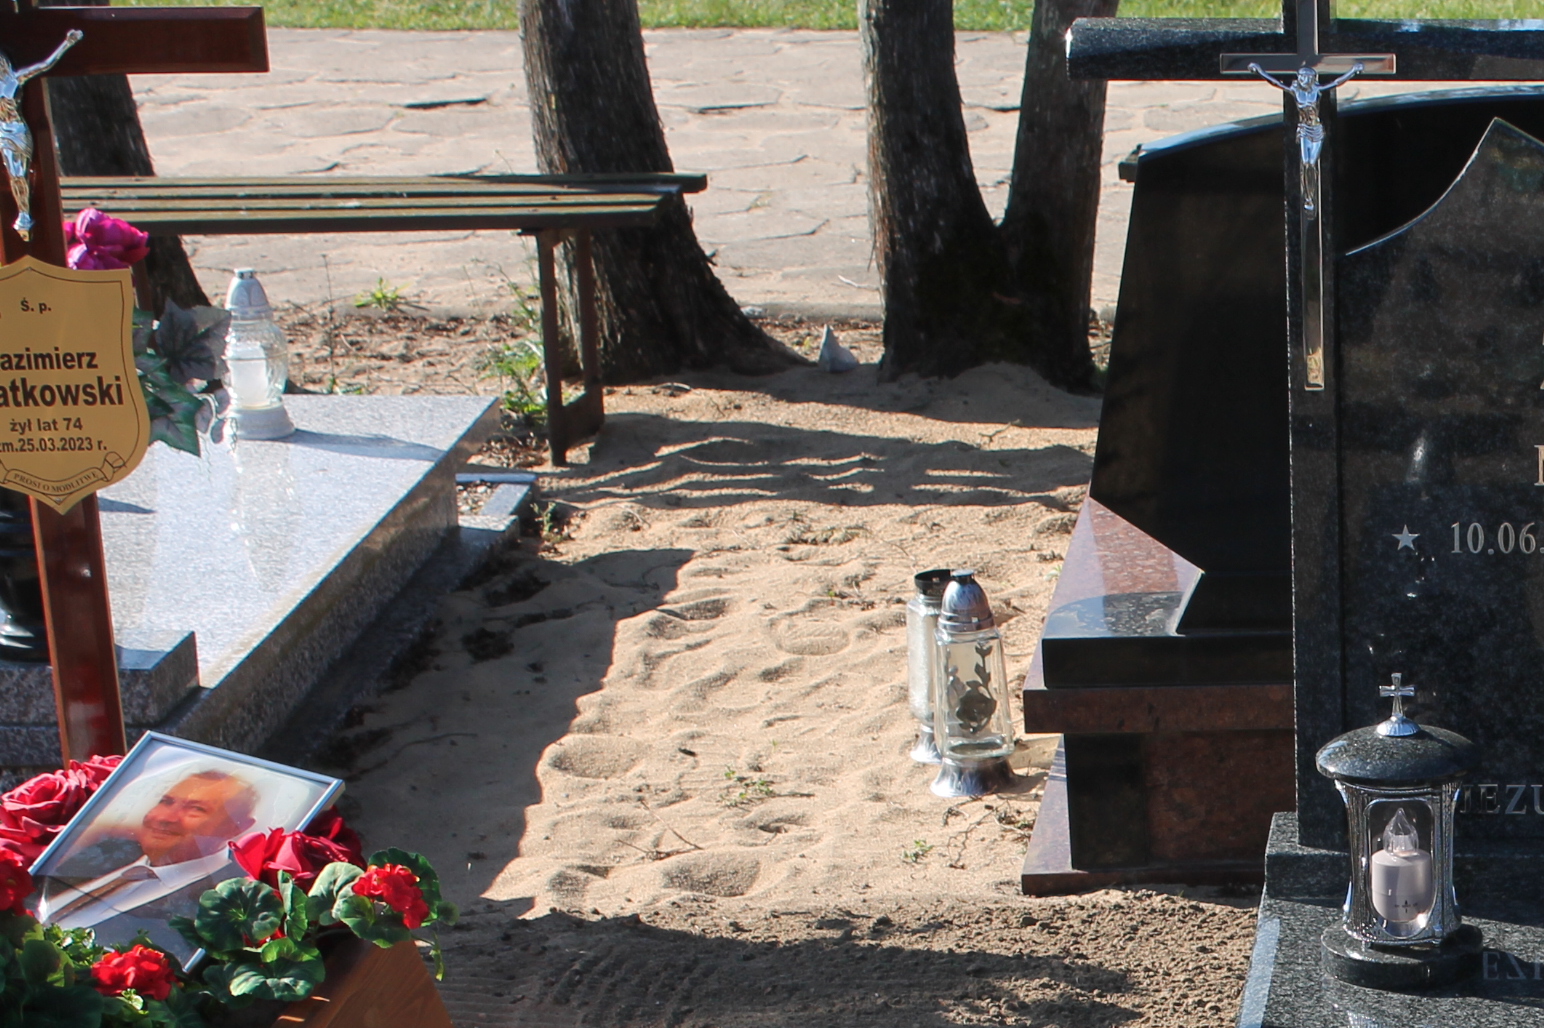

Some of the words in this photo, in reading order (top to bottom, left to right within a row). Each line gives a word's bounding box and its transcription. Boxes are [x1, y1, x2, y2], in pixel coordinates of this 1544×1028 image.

[0, 346, 99, 371] azimierz
[0, 375, 124, 407] atkowski
[10, 418, 32, 435] żył
[37, 418, 58, 431] lat
[63, 417, 83, 431] 74
[0, 436, 93, 453] m.25.03.2023
[97, 440, 107, 451] r.
[13, 472, 41, 487] PROSI
[43, 483, 50, 492] O
